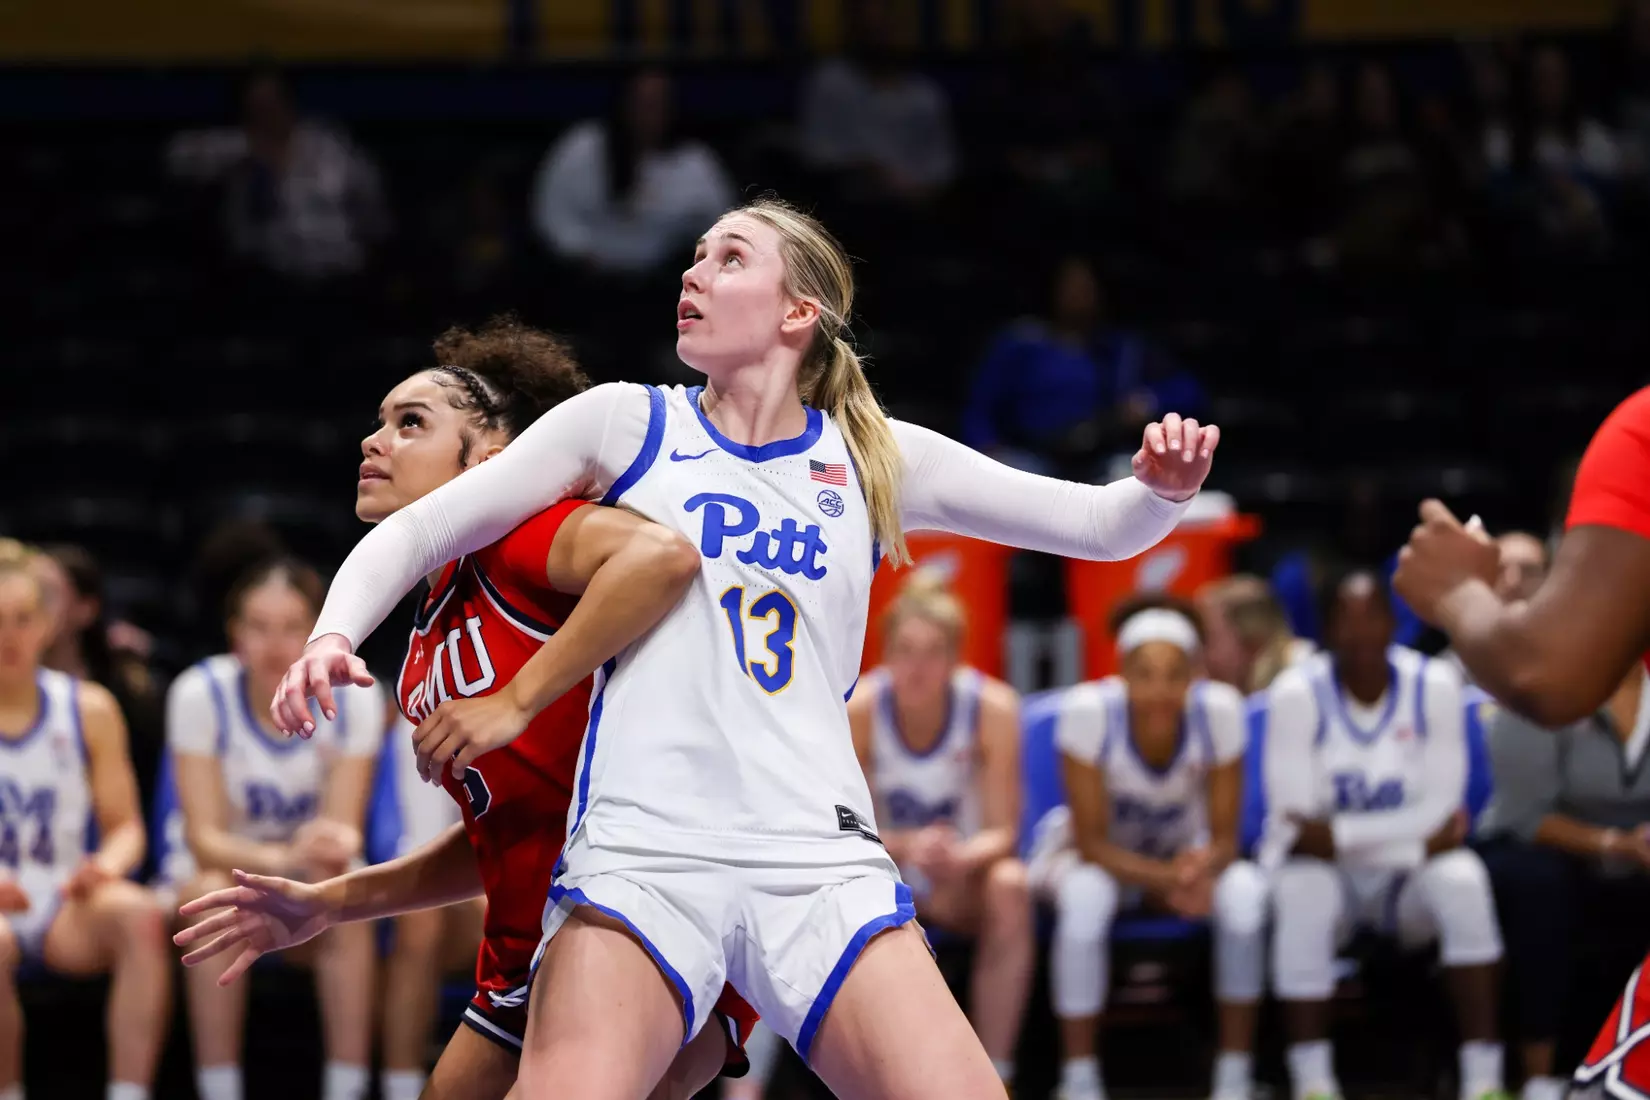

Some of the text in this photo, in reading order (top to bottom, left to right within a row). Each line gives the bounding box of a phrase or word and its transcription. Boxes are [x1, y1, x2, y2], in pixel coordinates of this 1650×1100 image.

[683, 492, 828, 581] Pitt
[819, 498, 842, 509] ACC
[719, 585, 798, 696] 13
